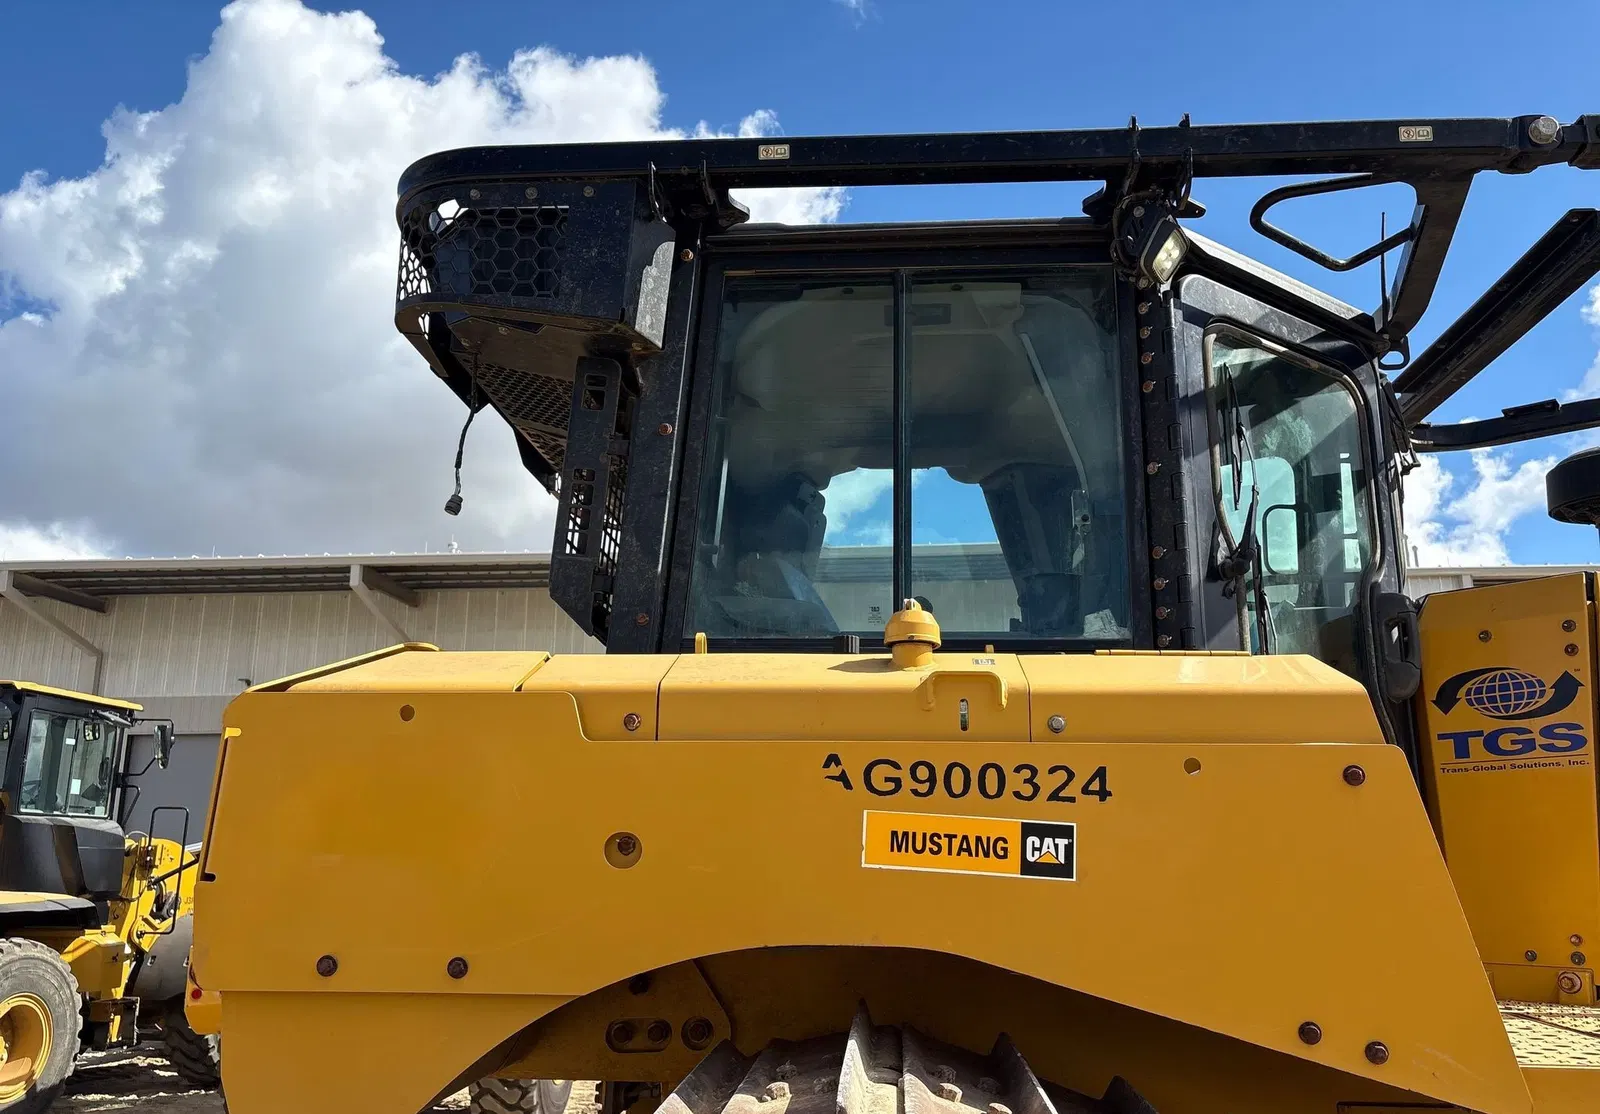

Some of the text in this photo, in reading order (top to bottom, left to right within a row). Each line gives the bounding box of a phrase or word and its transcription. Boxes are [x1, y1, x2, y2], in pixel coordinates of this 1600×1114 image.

[1437, 722, 1588, 760] TGS
[822, 753, 1113, 803] AG900324
[1440, 759, 1590, 774] Trans-Global Solutions, Inc.
[890, 830, 1069, 864] MUSTANG CAT
